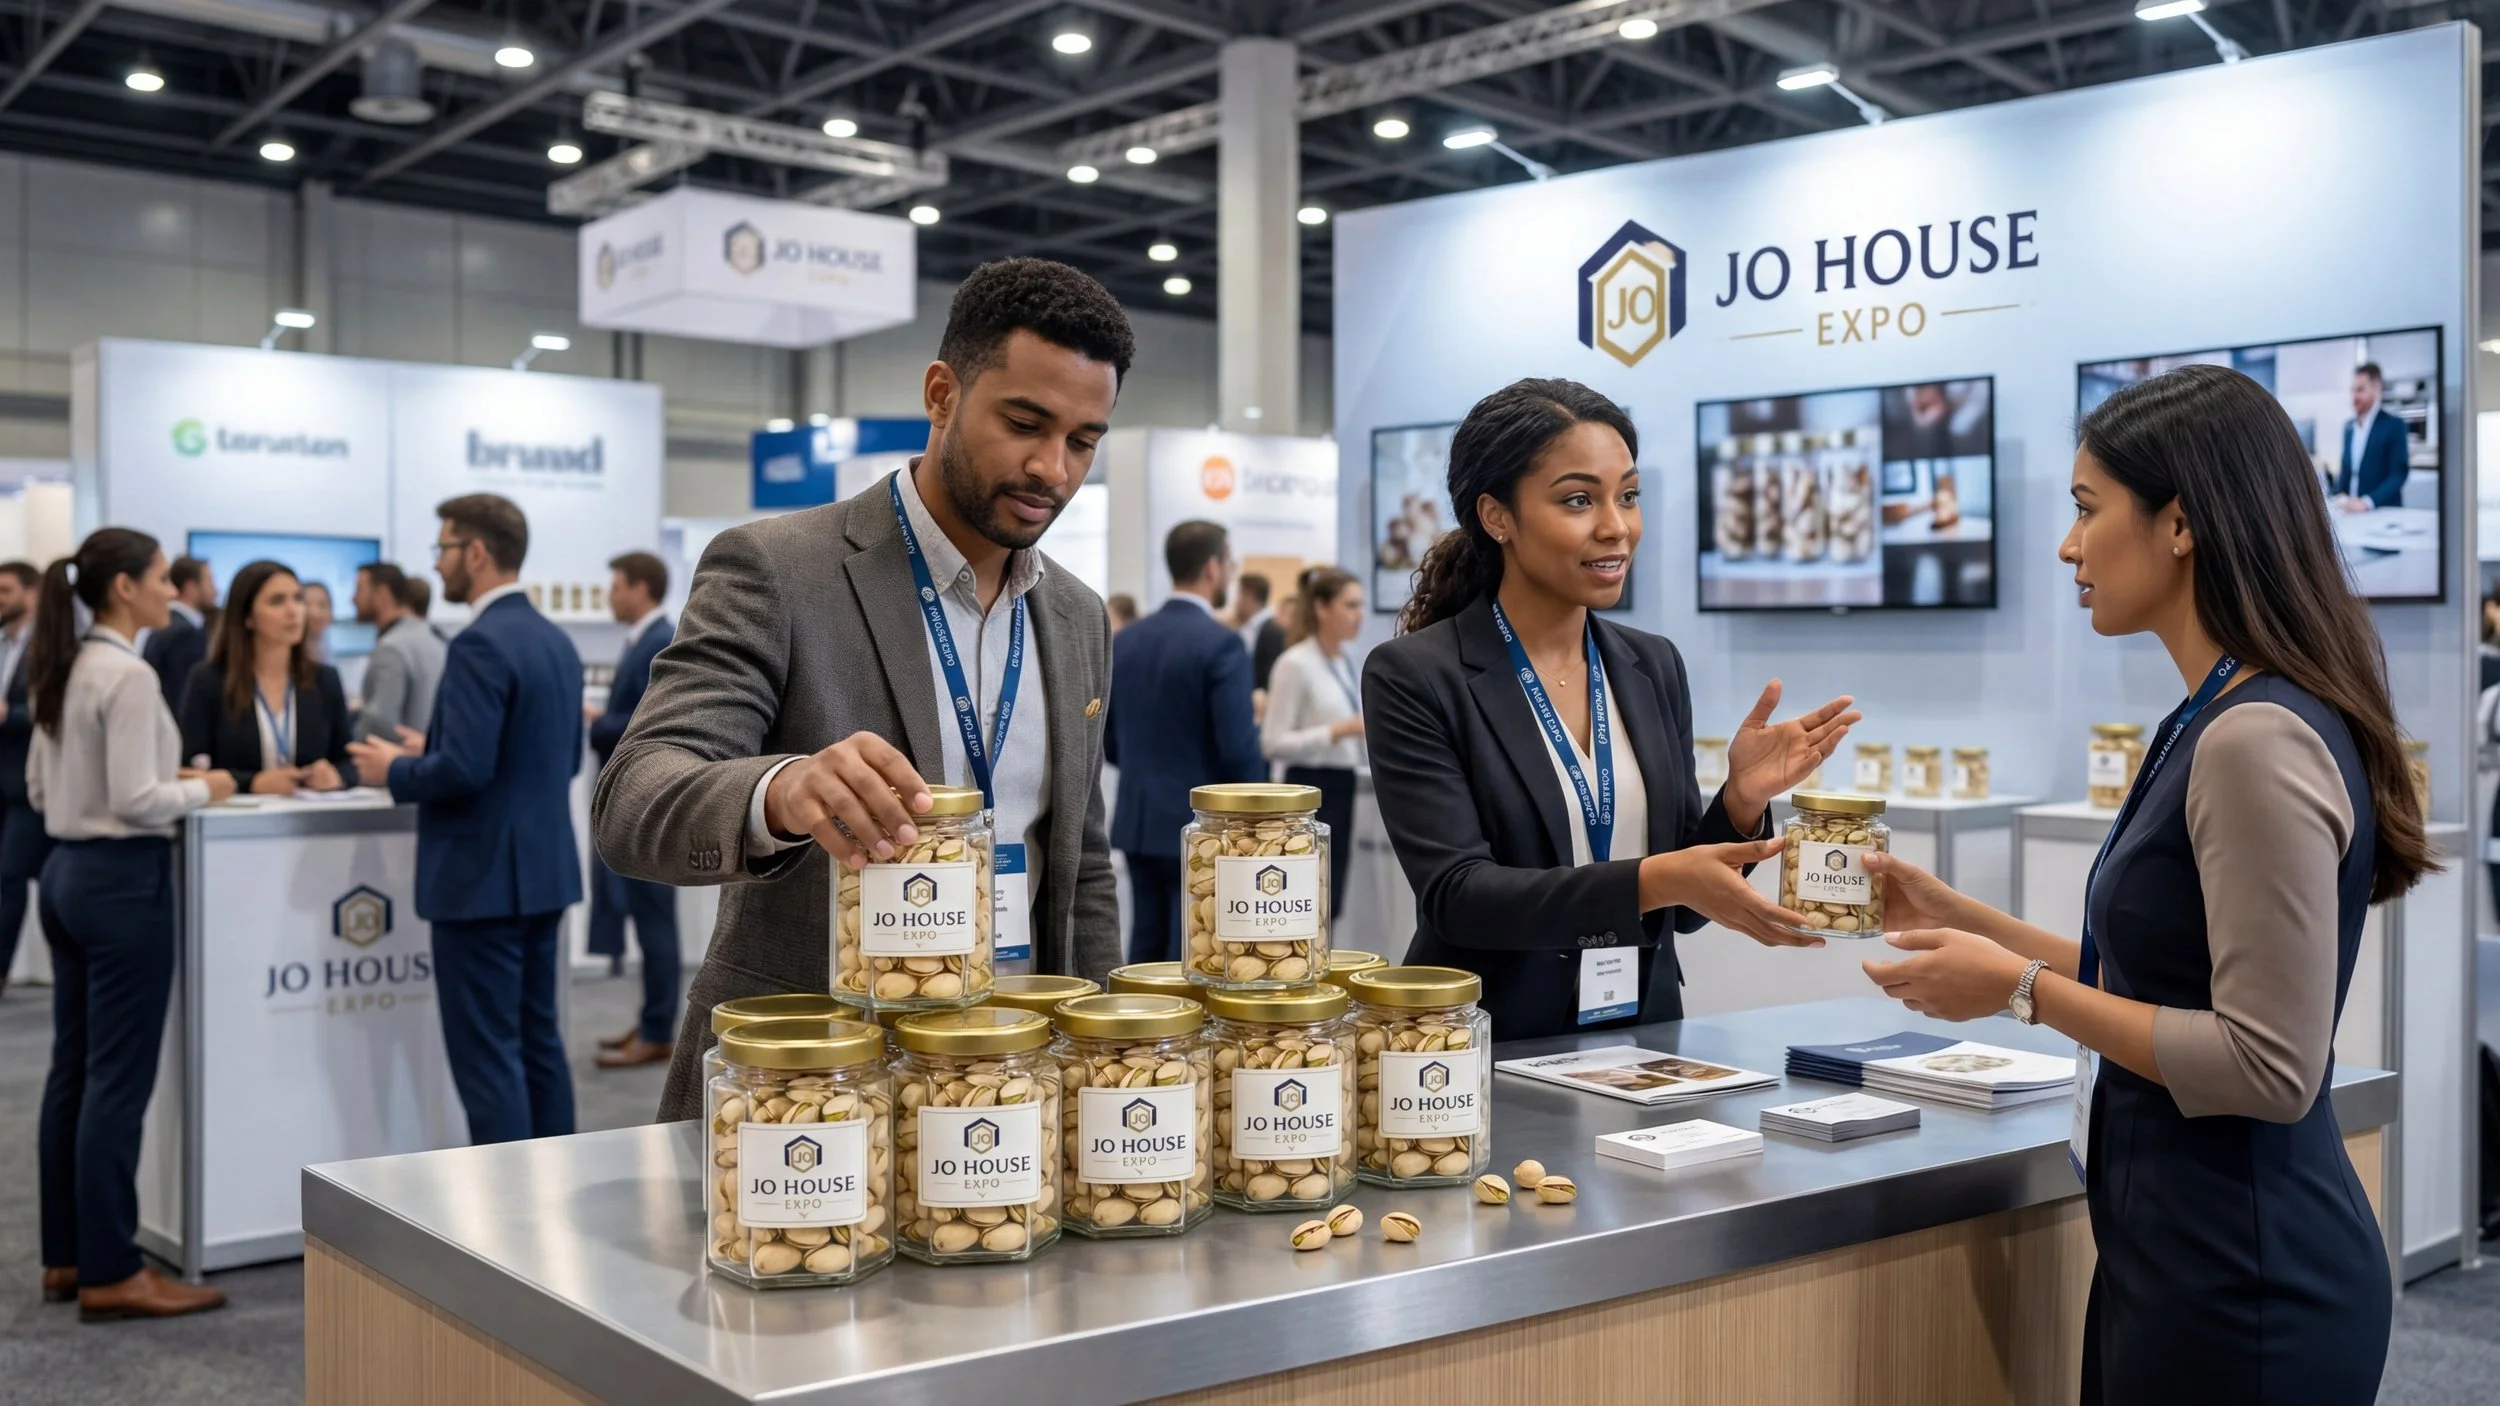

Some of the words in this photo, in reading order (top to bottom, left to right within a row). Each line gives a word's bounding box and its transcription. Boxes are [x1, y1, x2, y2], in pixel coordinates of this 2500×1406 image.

[1715, 246, 1791, 307] JO
[1815, 209, 2039, 293] HOUSE
[1607, 284, 1657, 330] JO
[1817, 302, 1926, 346] EXPO
[1805, 872, 1820, 882] JO
[1823, 874, 1865, 886] HOUSE
[1227, 900, 1249, 914] JO
[1255, 899, 1312, 914] HOUSE
[873, 912, 896, 927] JO
[903, 911, 966, 927] HOUSE
[1255, 917, 1287, 926] EXPO
[903, 930, 937, 940] EXPO
[266, 962, 310, 998] JO
[324, 953, 431, 989] HOUS
[1390, 1097, 1413, 1111] JO
[1418, 1093, 1474, 1111] HOUSE
[1244, 1116, 1267, 1131] JO
[1274, 1113, 1334, 1131] HOUSE
[1419, 1113, 1450, 1123] EXPO
[1091, 1138, 1115, 1153] JO
[1122, 1135, 1186, 1153] HOUSE
[1274, 1133, 1307, 1143] EXPO
[931, 1159, 956, 1175] JO
[964, 1156, 1031, 1175] HOUSE
[1123, 1156, 1157, 1167] EXPO
[751, 1178, 776, 1195] JO
[784, 1175, 855, 1195] HOUSE
[964, 1178, 1000, 1189] EXPO
[785, 1198, 822, 1210] EXPO
